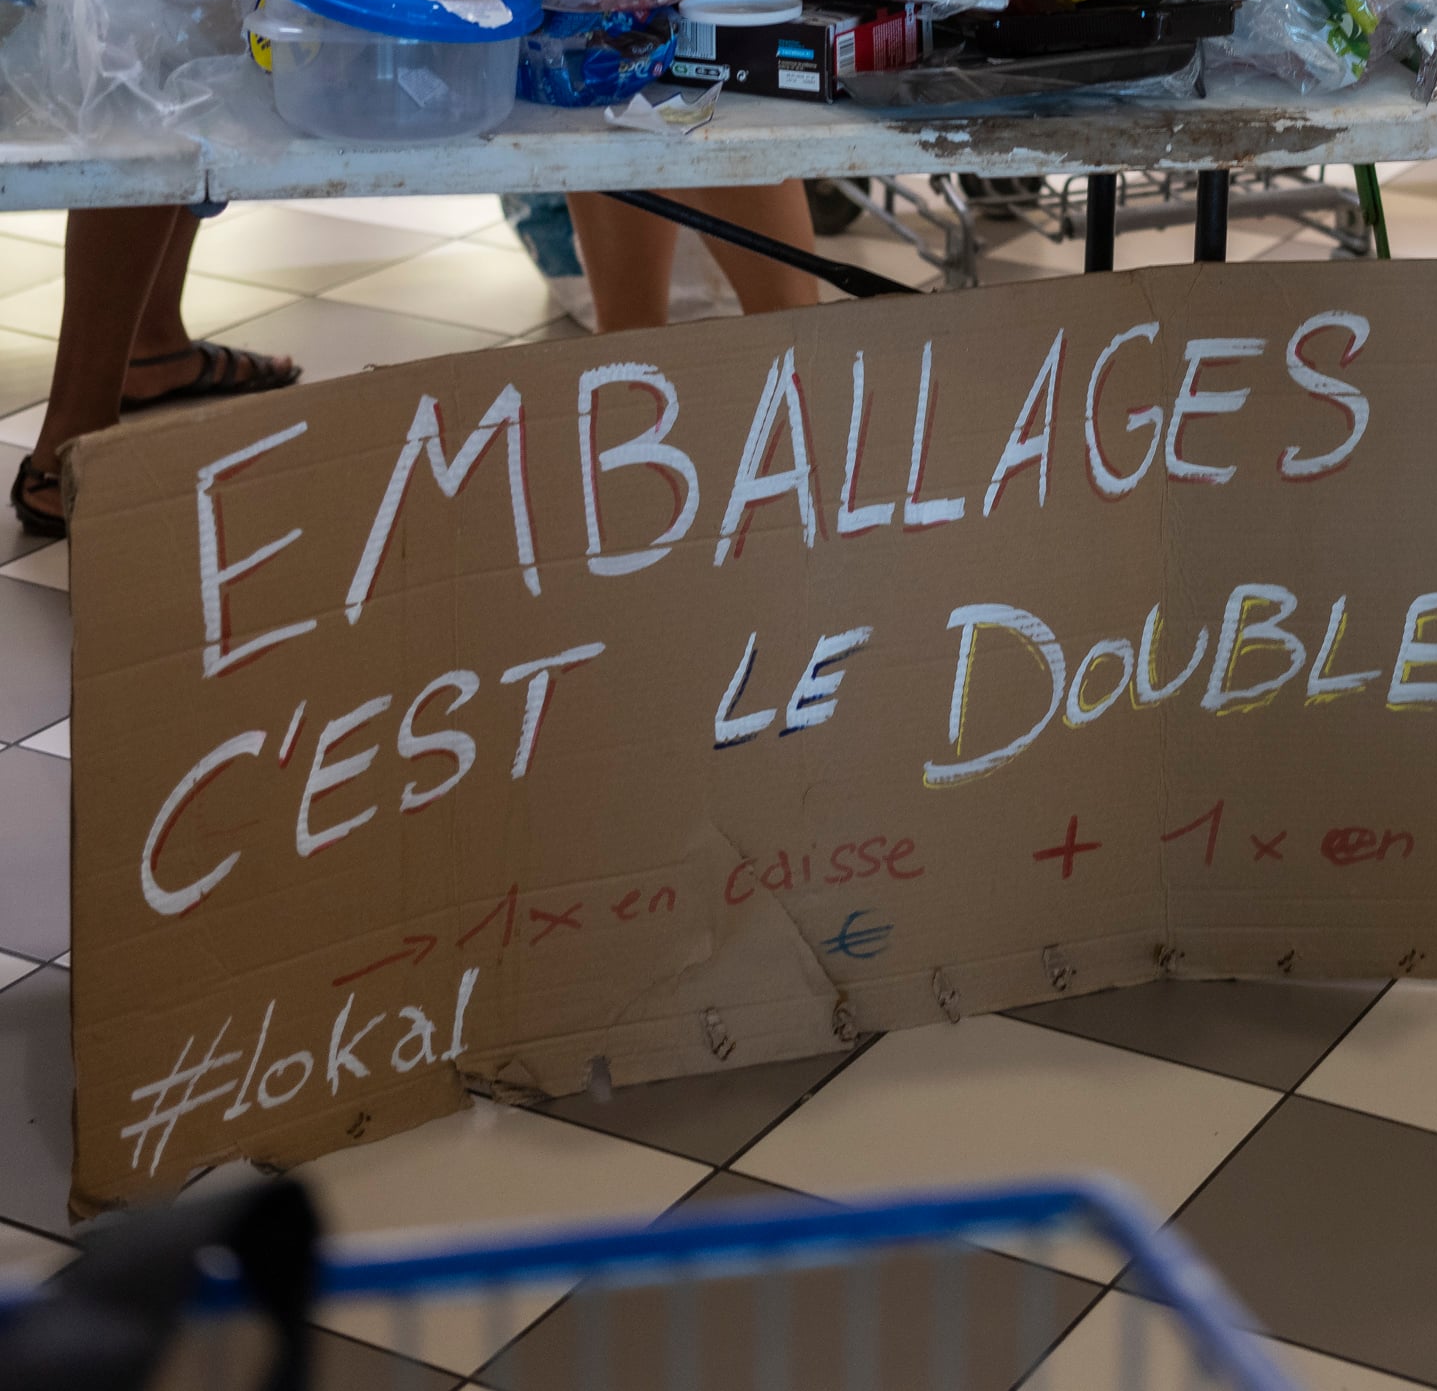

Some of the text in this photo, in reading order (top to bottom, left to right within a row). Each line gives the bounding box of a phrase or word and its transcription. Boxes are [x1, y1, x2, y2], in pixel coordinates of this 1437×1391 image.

[197, 311, 1373, 678] EMBALLAGES
[139, 641, 607, 917] C'EST
[712, 625, 874, 750] LE
[611, 885, 677, 921] en
[723, 833, 926, 903] caisse
[119, 967, 480, 1178] #lokal
